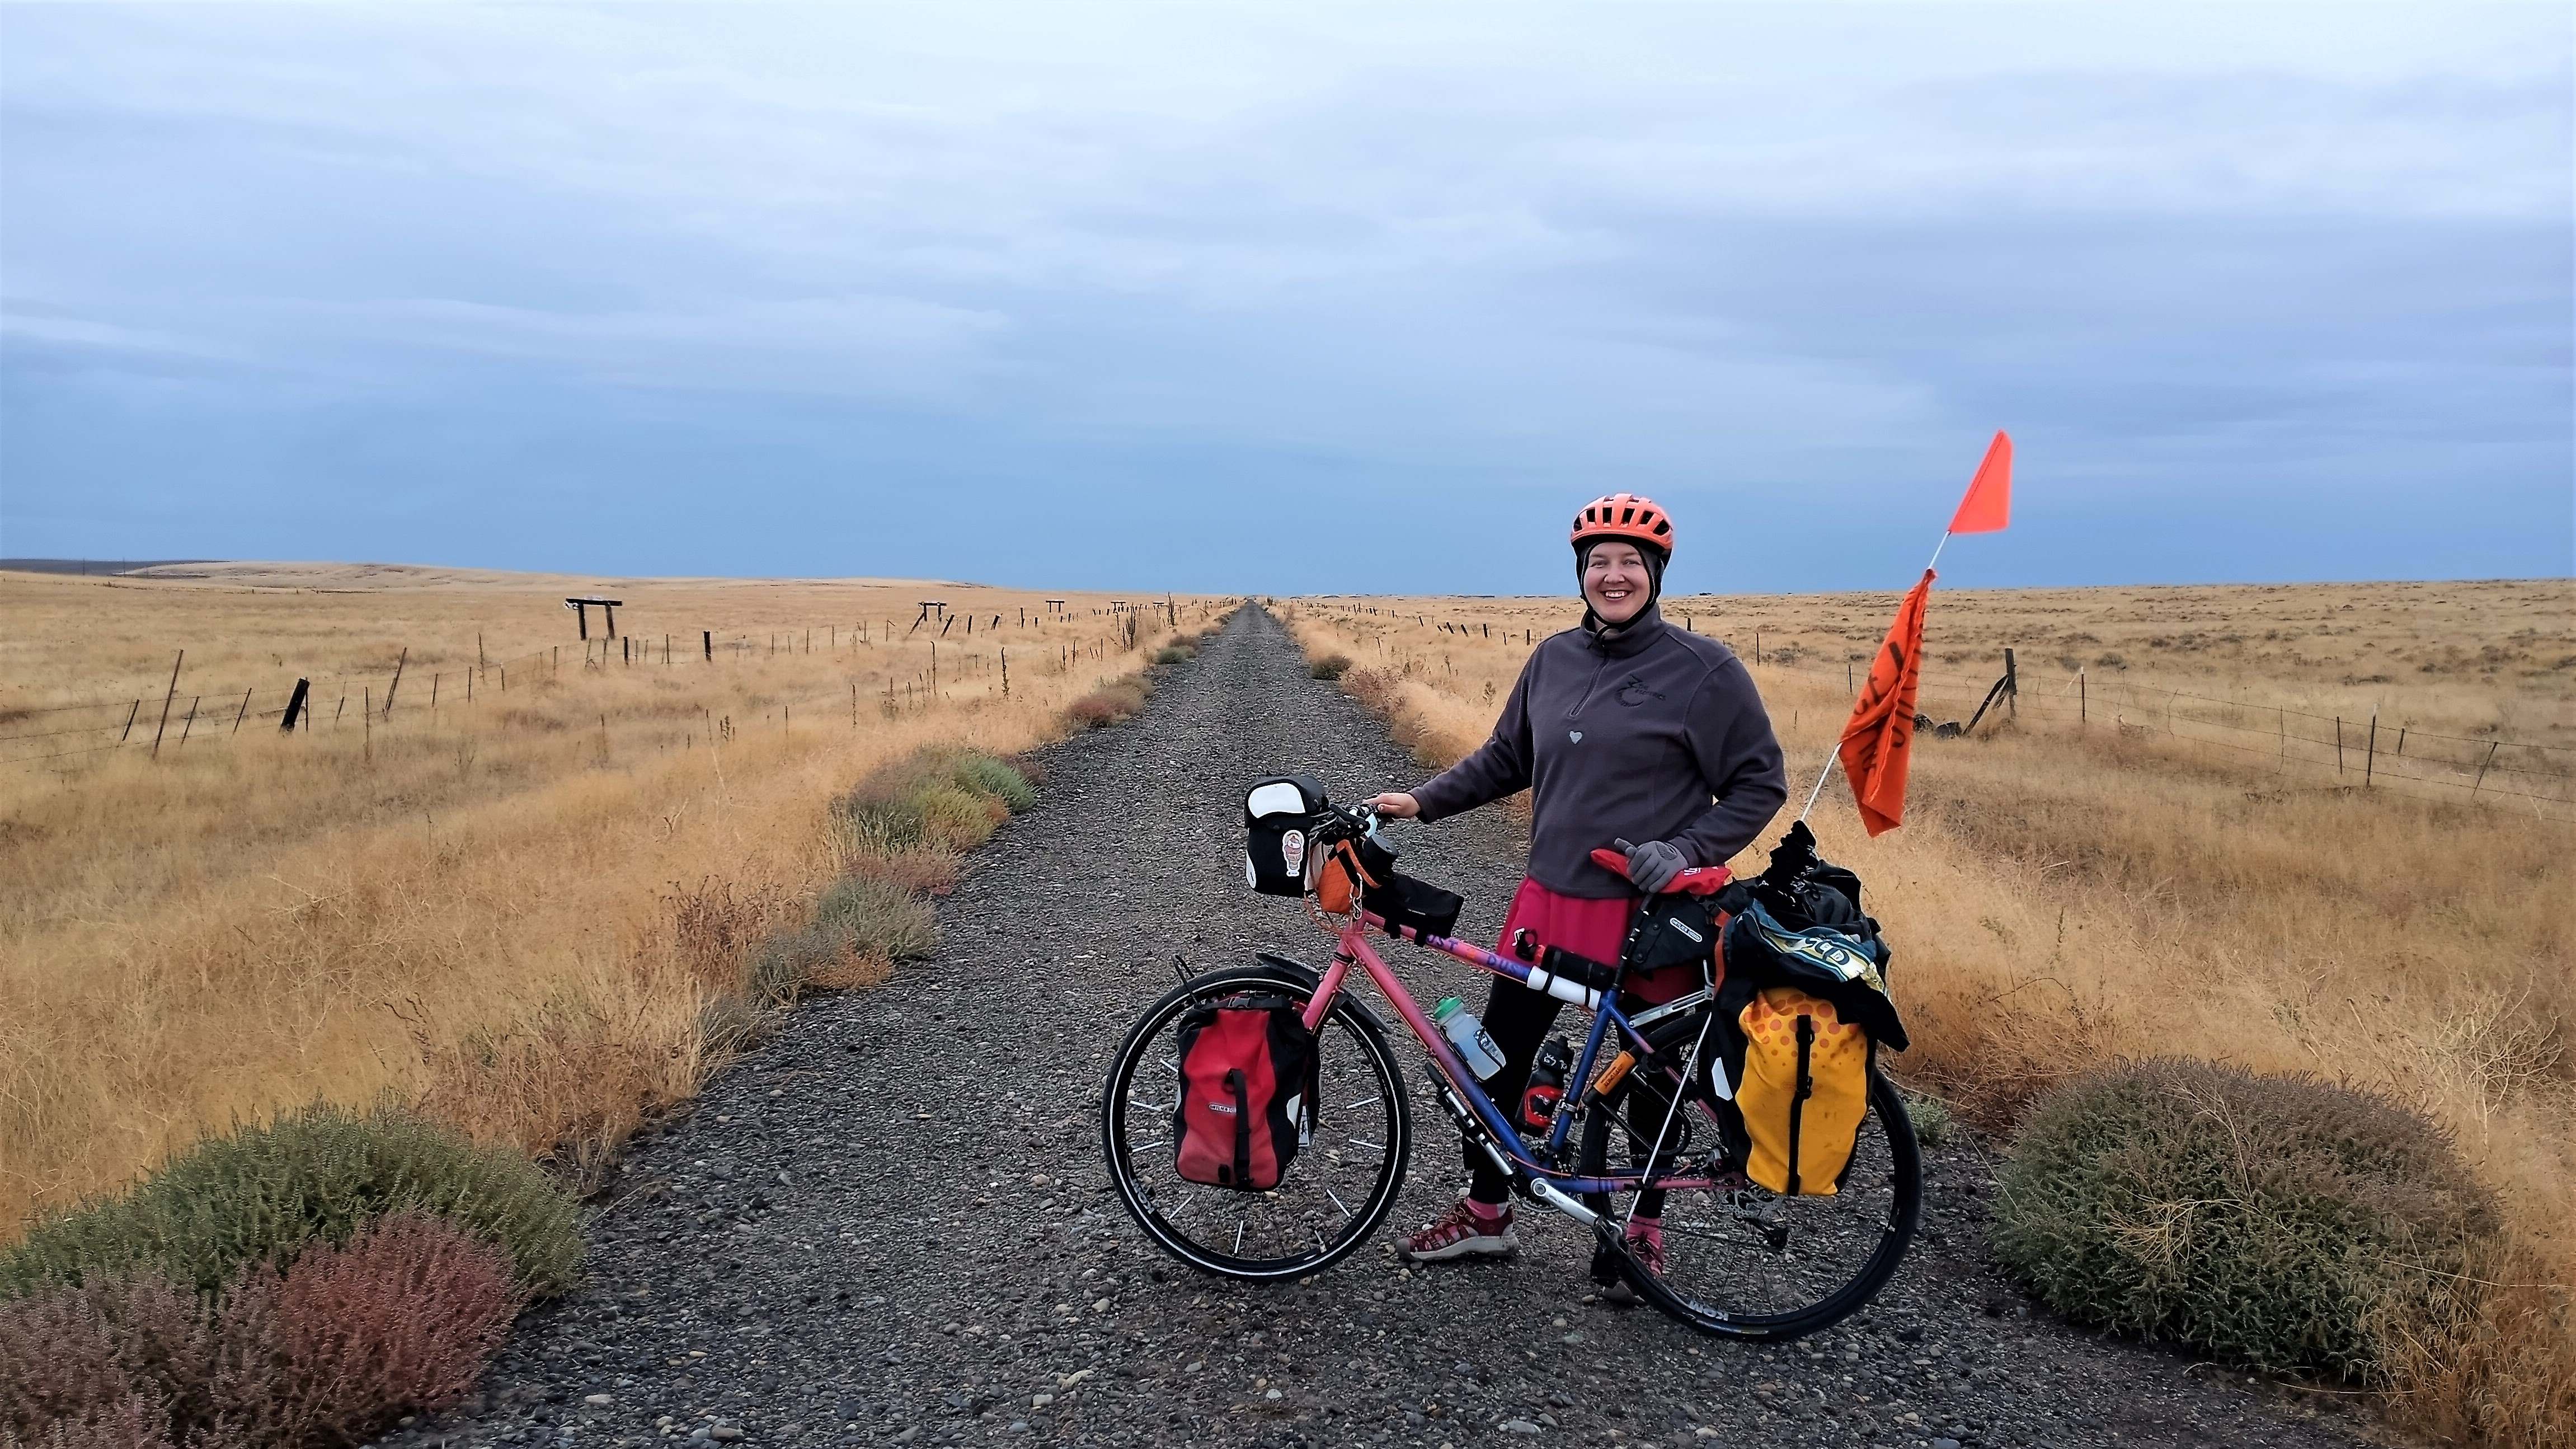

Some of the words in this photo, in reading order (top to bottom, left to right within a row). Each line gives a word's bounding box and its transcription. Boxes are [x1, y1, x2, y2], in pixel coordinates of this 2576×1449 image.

[1426, 934, 1459, 951] UST
[1132, 1178, 1155, 1214] KOM
[1689, 1298, 1729, 1321] KOM
